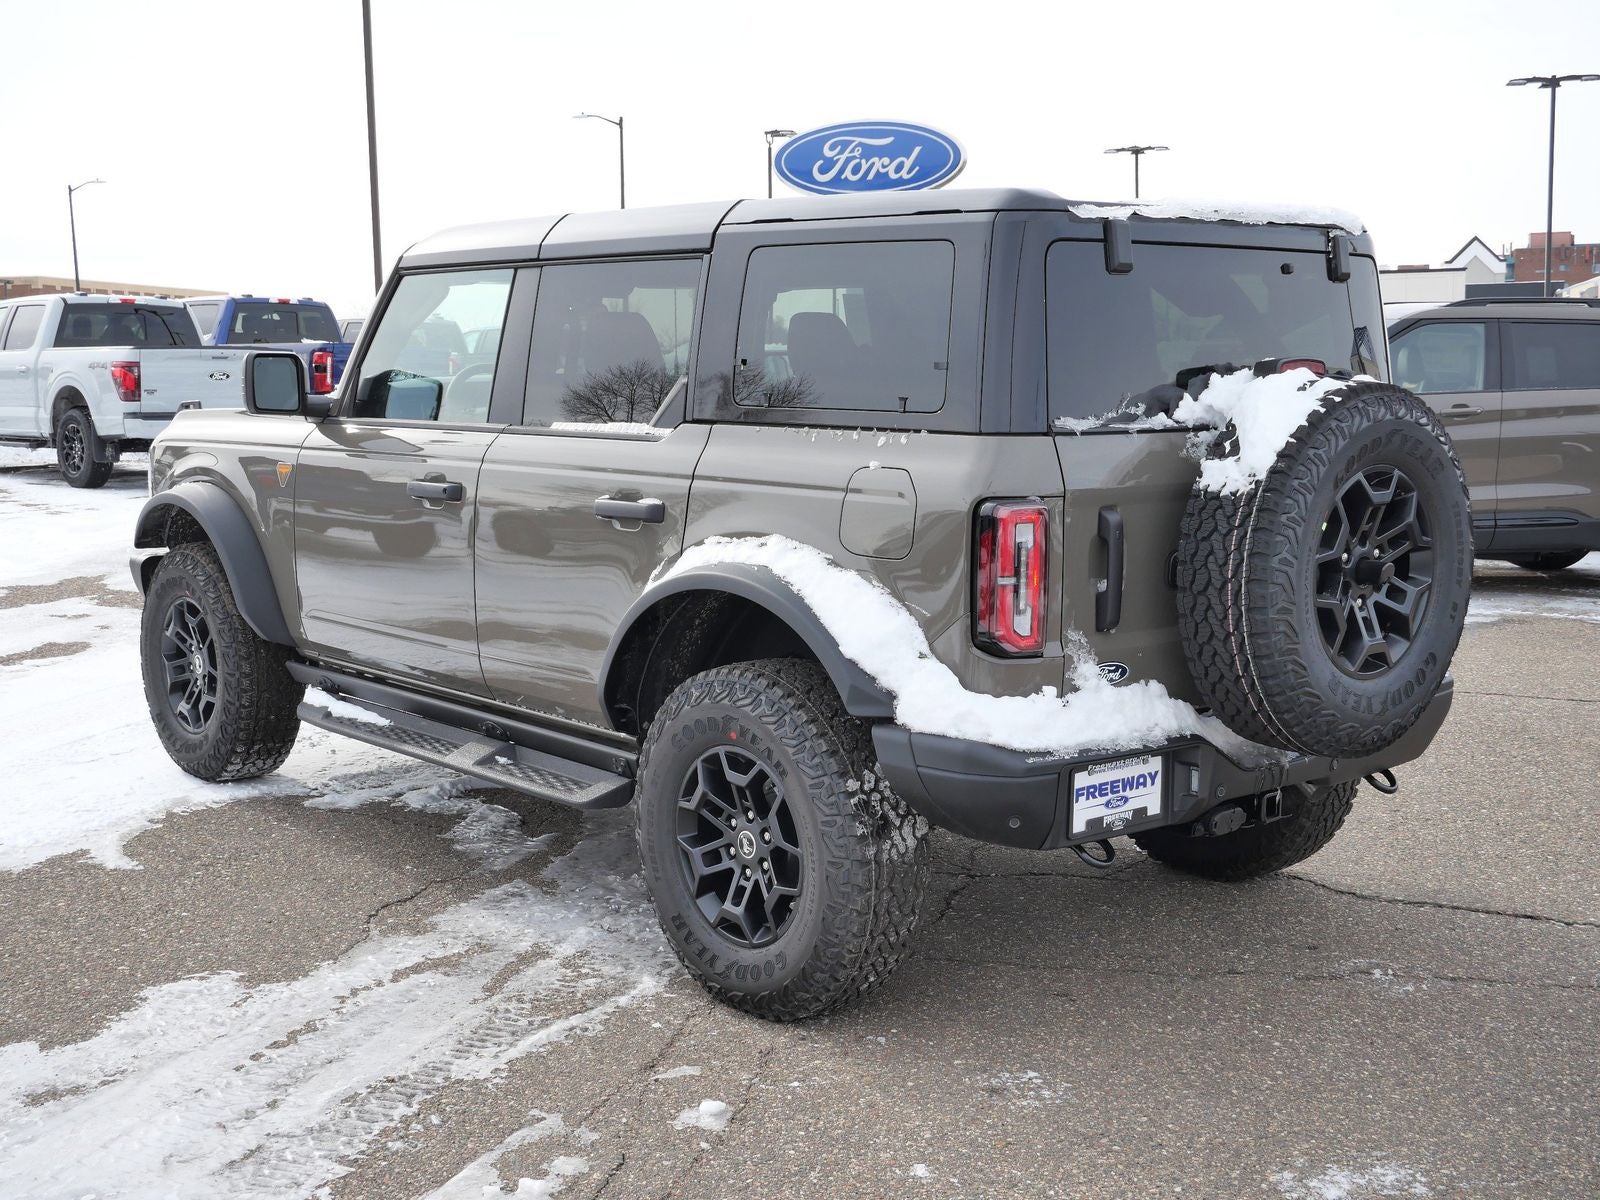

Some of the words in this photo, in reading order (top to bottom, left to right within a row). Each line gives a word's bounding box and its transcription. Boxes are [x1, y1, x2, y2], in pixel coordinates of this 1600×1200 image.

[812, 136, 923, 183] Ford
[1097, 665, 1122, 681] Ford
[1327, 651, 1438, 717] GOODYEAR
[671, 713, 789, 782] GOODYEAR
[1074, 770, 1160, 804] FREEWAY
[1103, 809, 1133, 828] FREEWAY
[670, 911, 788, 983] GOODYEAR
